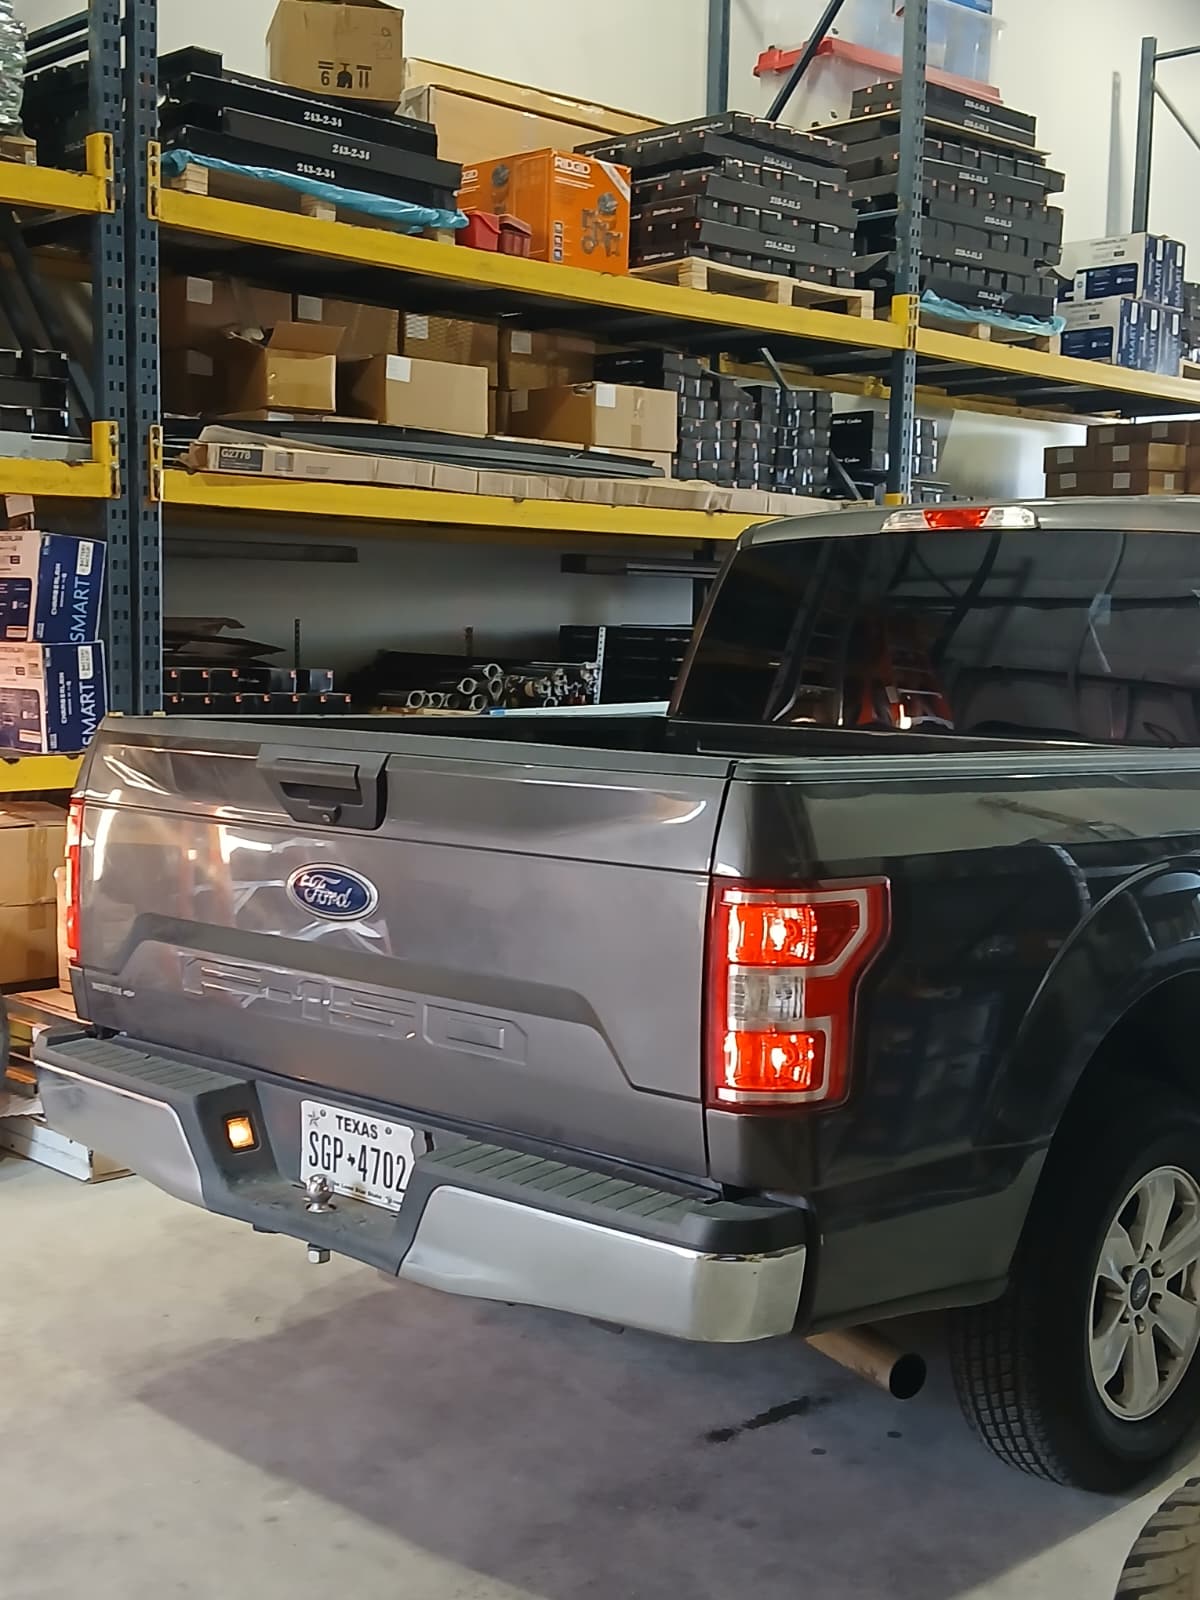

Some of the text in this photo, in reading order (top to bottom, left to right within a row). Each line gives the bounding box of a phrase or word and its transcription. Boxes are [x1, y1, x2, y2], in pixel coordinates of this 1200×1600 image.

[555, 157, 591, 174] RIDGID
[70, 576, 91, 642] SMART
[79, 681, 96, 746] SMART
[300, 874, 352, 908] Ford
[335, 1114, 378, 1140] TEXAS
[308, 1130, 406, 1193] SGP 4702
